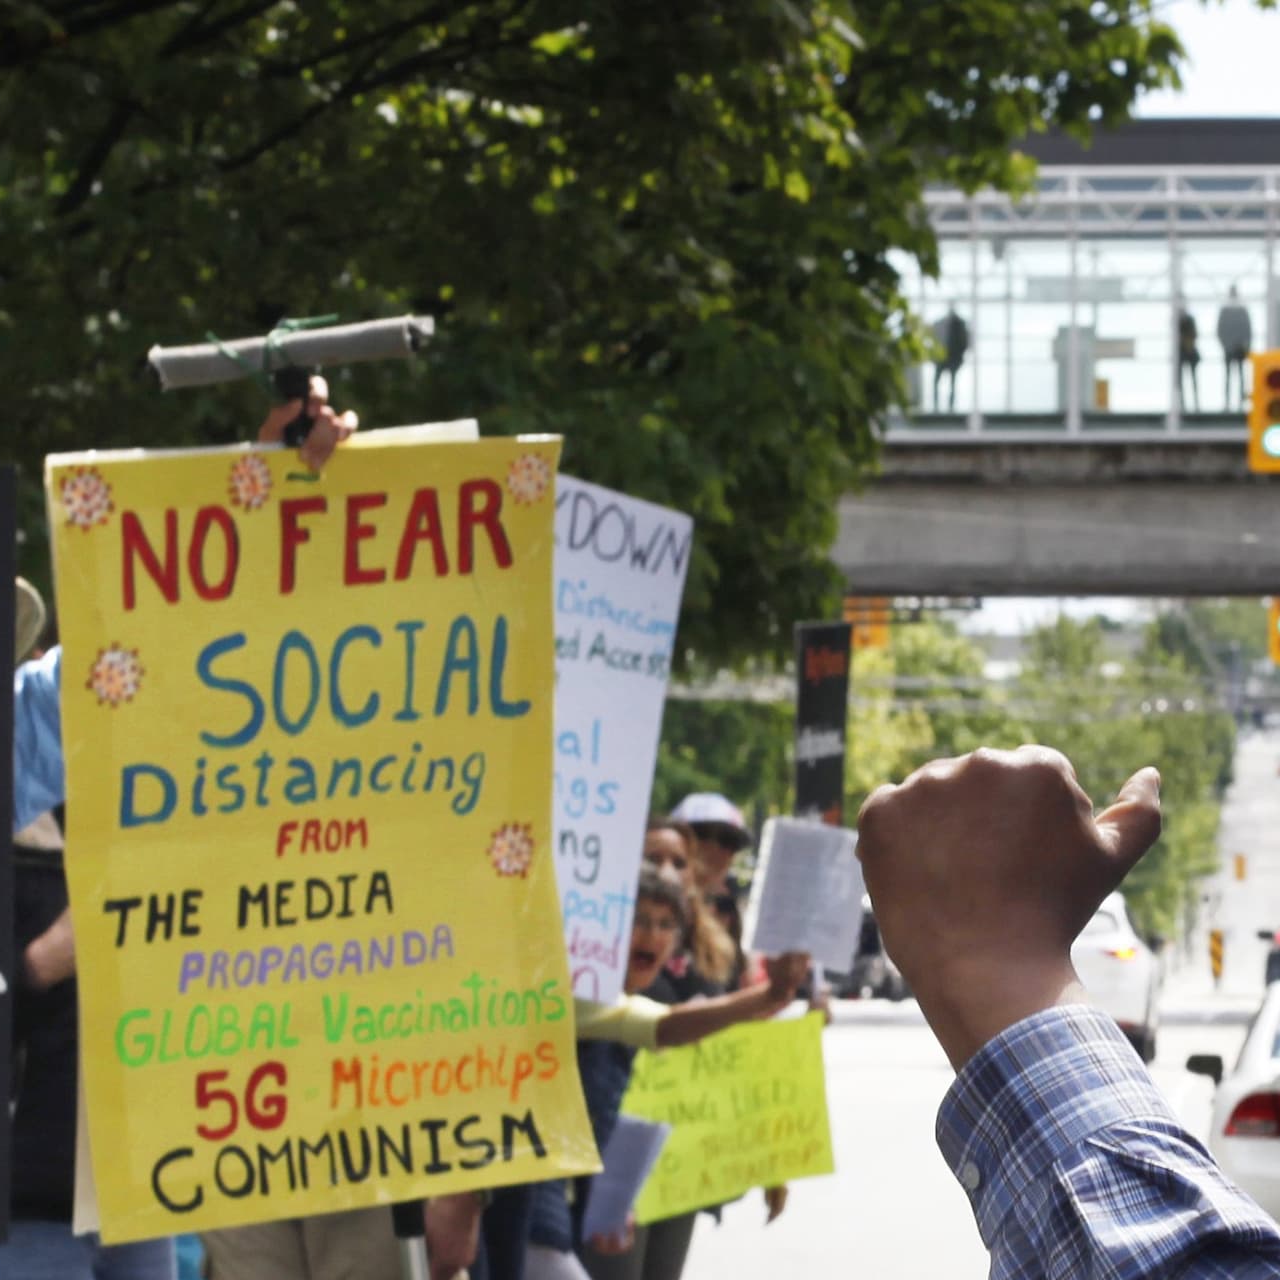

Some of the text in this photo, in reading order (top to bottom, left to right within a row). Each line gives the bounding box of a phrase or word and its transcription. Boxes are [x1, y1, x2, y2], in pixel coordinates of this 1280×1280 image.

[122, 479, 513, 610] NO FEAR
[556, 490, 692, 576] DOWN
[196, 615, 531, 748] SOCIAL
[120, 741, 486, 829] Distancing
[556, 718, 602, 766] al
[275, 818, 369, 858] FROM
[558, 828, 604, 886] ng
[103, 871, 395, 949] THE MEDIA
[178, 923, 456, 994] PROPAGANDA
[114, 1002, 300, 1068] GLOBAL
[321, 971, 568, 1045] Vaccinations
[195, 1061, 289, 1142] 5G
[330, 1041, 561, 1110] Microchips
[151, 1108, 549, 1214] COMMUNISM
